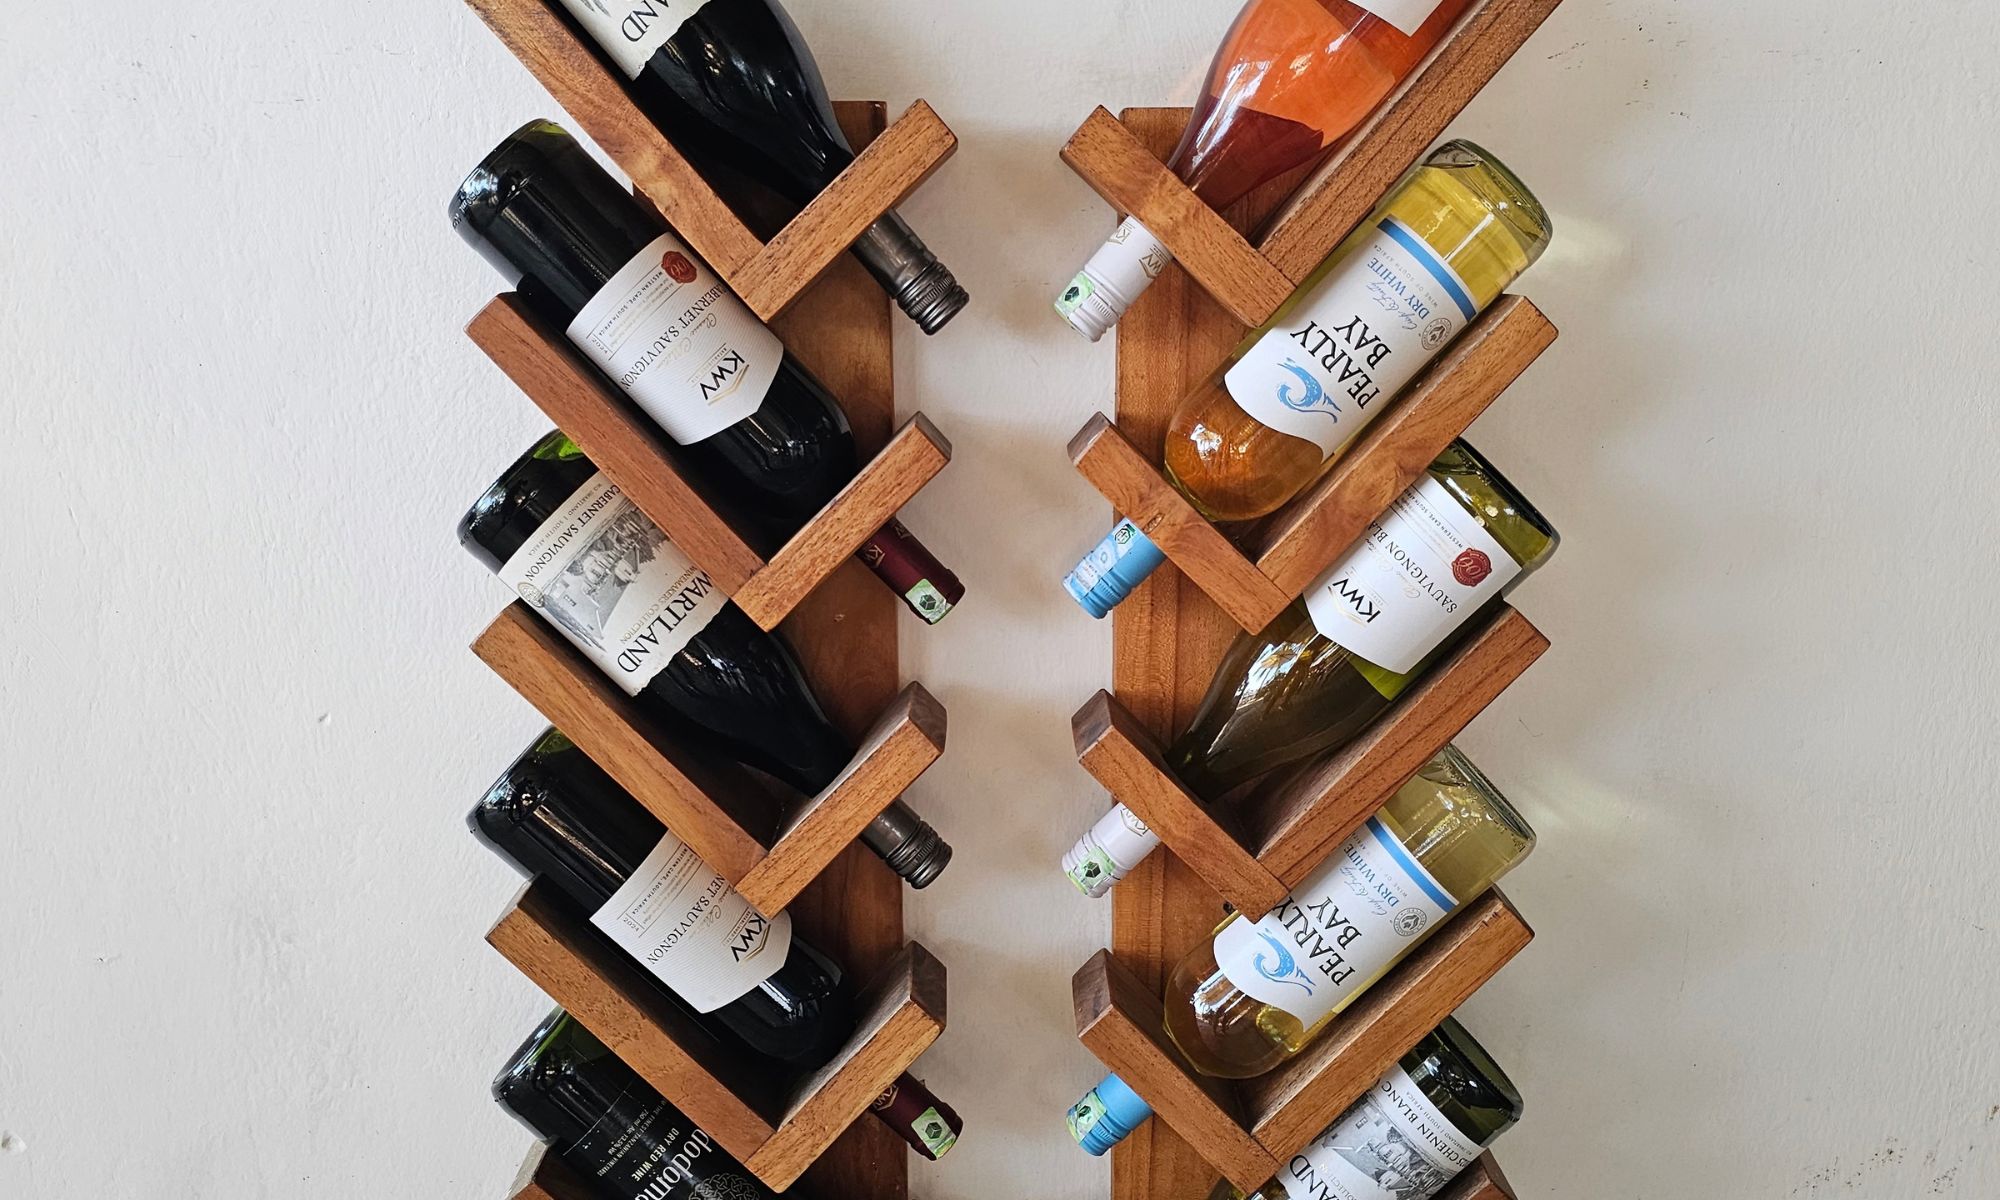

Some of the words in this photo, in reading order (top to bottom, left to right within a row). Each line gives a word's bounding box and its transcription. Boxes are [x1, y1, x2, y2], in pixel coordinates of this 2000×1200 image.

[1367, 257, 1406, 296] WHITE
[1404, 294, 1430, 320] DRY
[616, 325, 679, 392] SAUVIGNON
[1333, 315, 1391, 370] BAY
[700, 350, 745, 400] KWV
[1290, 320, 1380, 410] PEARLY
[577, 483, 621, 527] CABERNET
[525, 523, 579, 580] SAUVIGNON
[1332, 578, 1381, 623] KWV
[1385, 542, 1458, 615] SAUVIGNON
[1340, 840, 1375, 882] WHITE
[1373, 883, 1400, 907] DRY
[647, 895, 710, 964] SAUVIGNON
[731, 910, 767, 962] KWV
[1272, 897, 1356, 986] PEARLY
[1307, 898, 1362, 949] BAY
[1381, 1080, 1419, 1123] BLANC
[616, 1132, 641, 1158] TANZANIAN
[649, 1144, 666, 1162] RED
[664, 1127, 679, 1146] DRY
[1417, 1123, 1459, 1162] CHENIN
[631, 1161, 652, 1181] WINE
